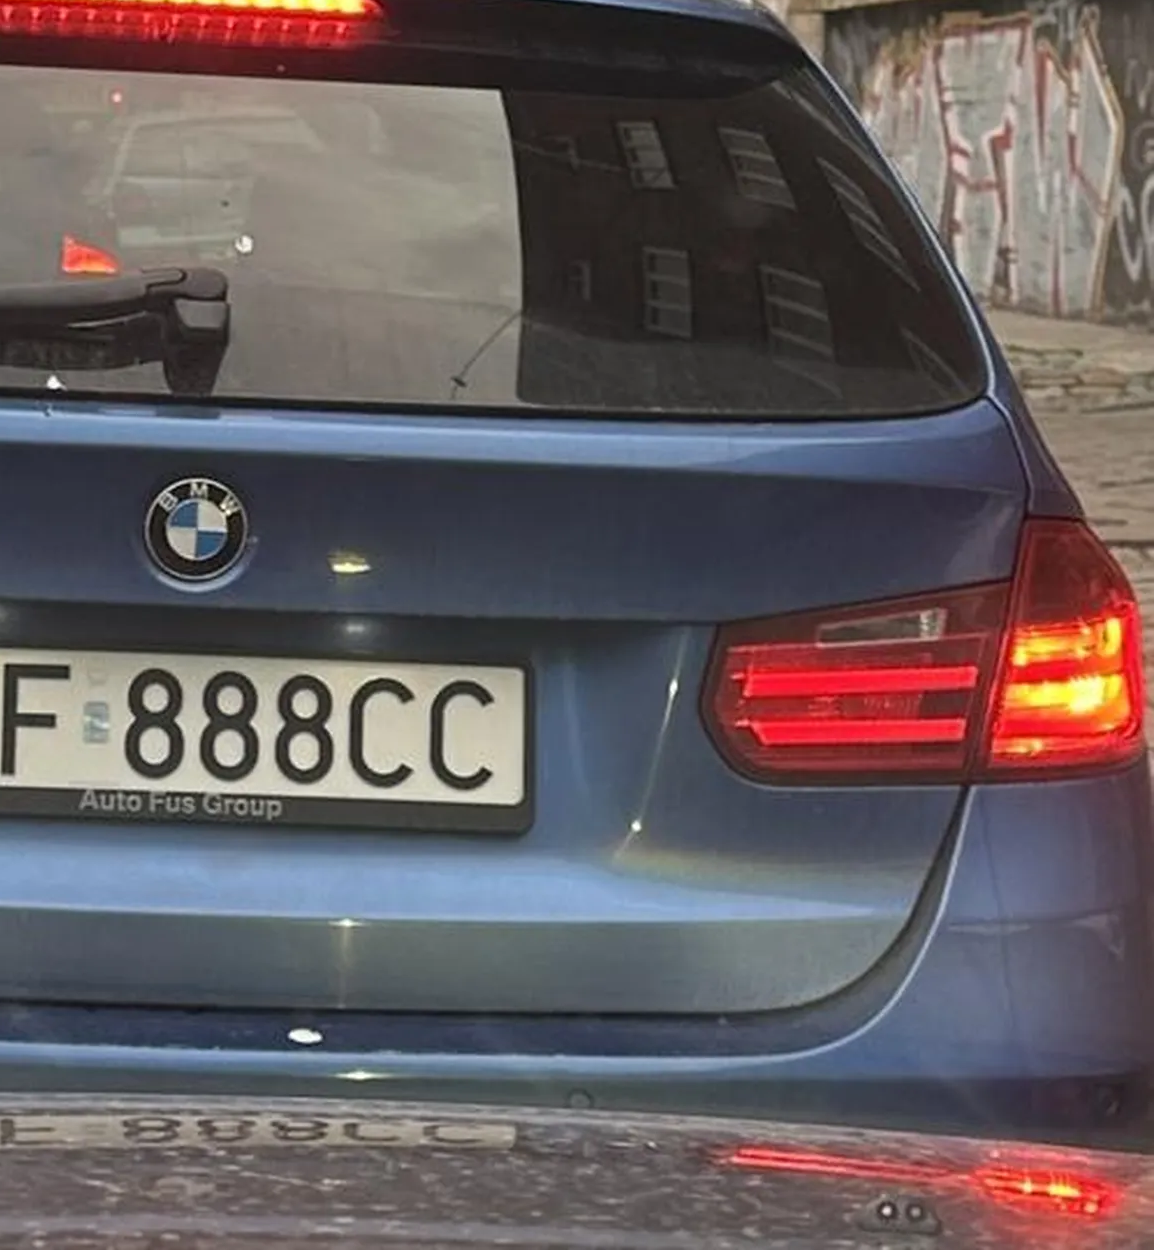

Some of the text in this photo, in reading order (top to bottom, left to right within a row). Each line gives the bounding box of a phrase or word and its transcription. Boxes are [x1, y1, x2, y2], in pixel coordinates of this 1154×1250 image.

[158, 482, 242, 515] BMW
[124, 668, 494, 791] 888CC
[78, 790, 283, 820] Auto Fus Group
